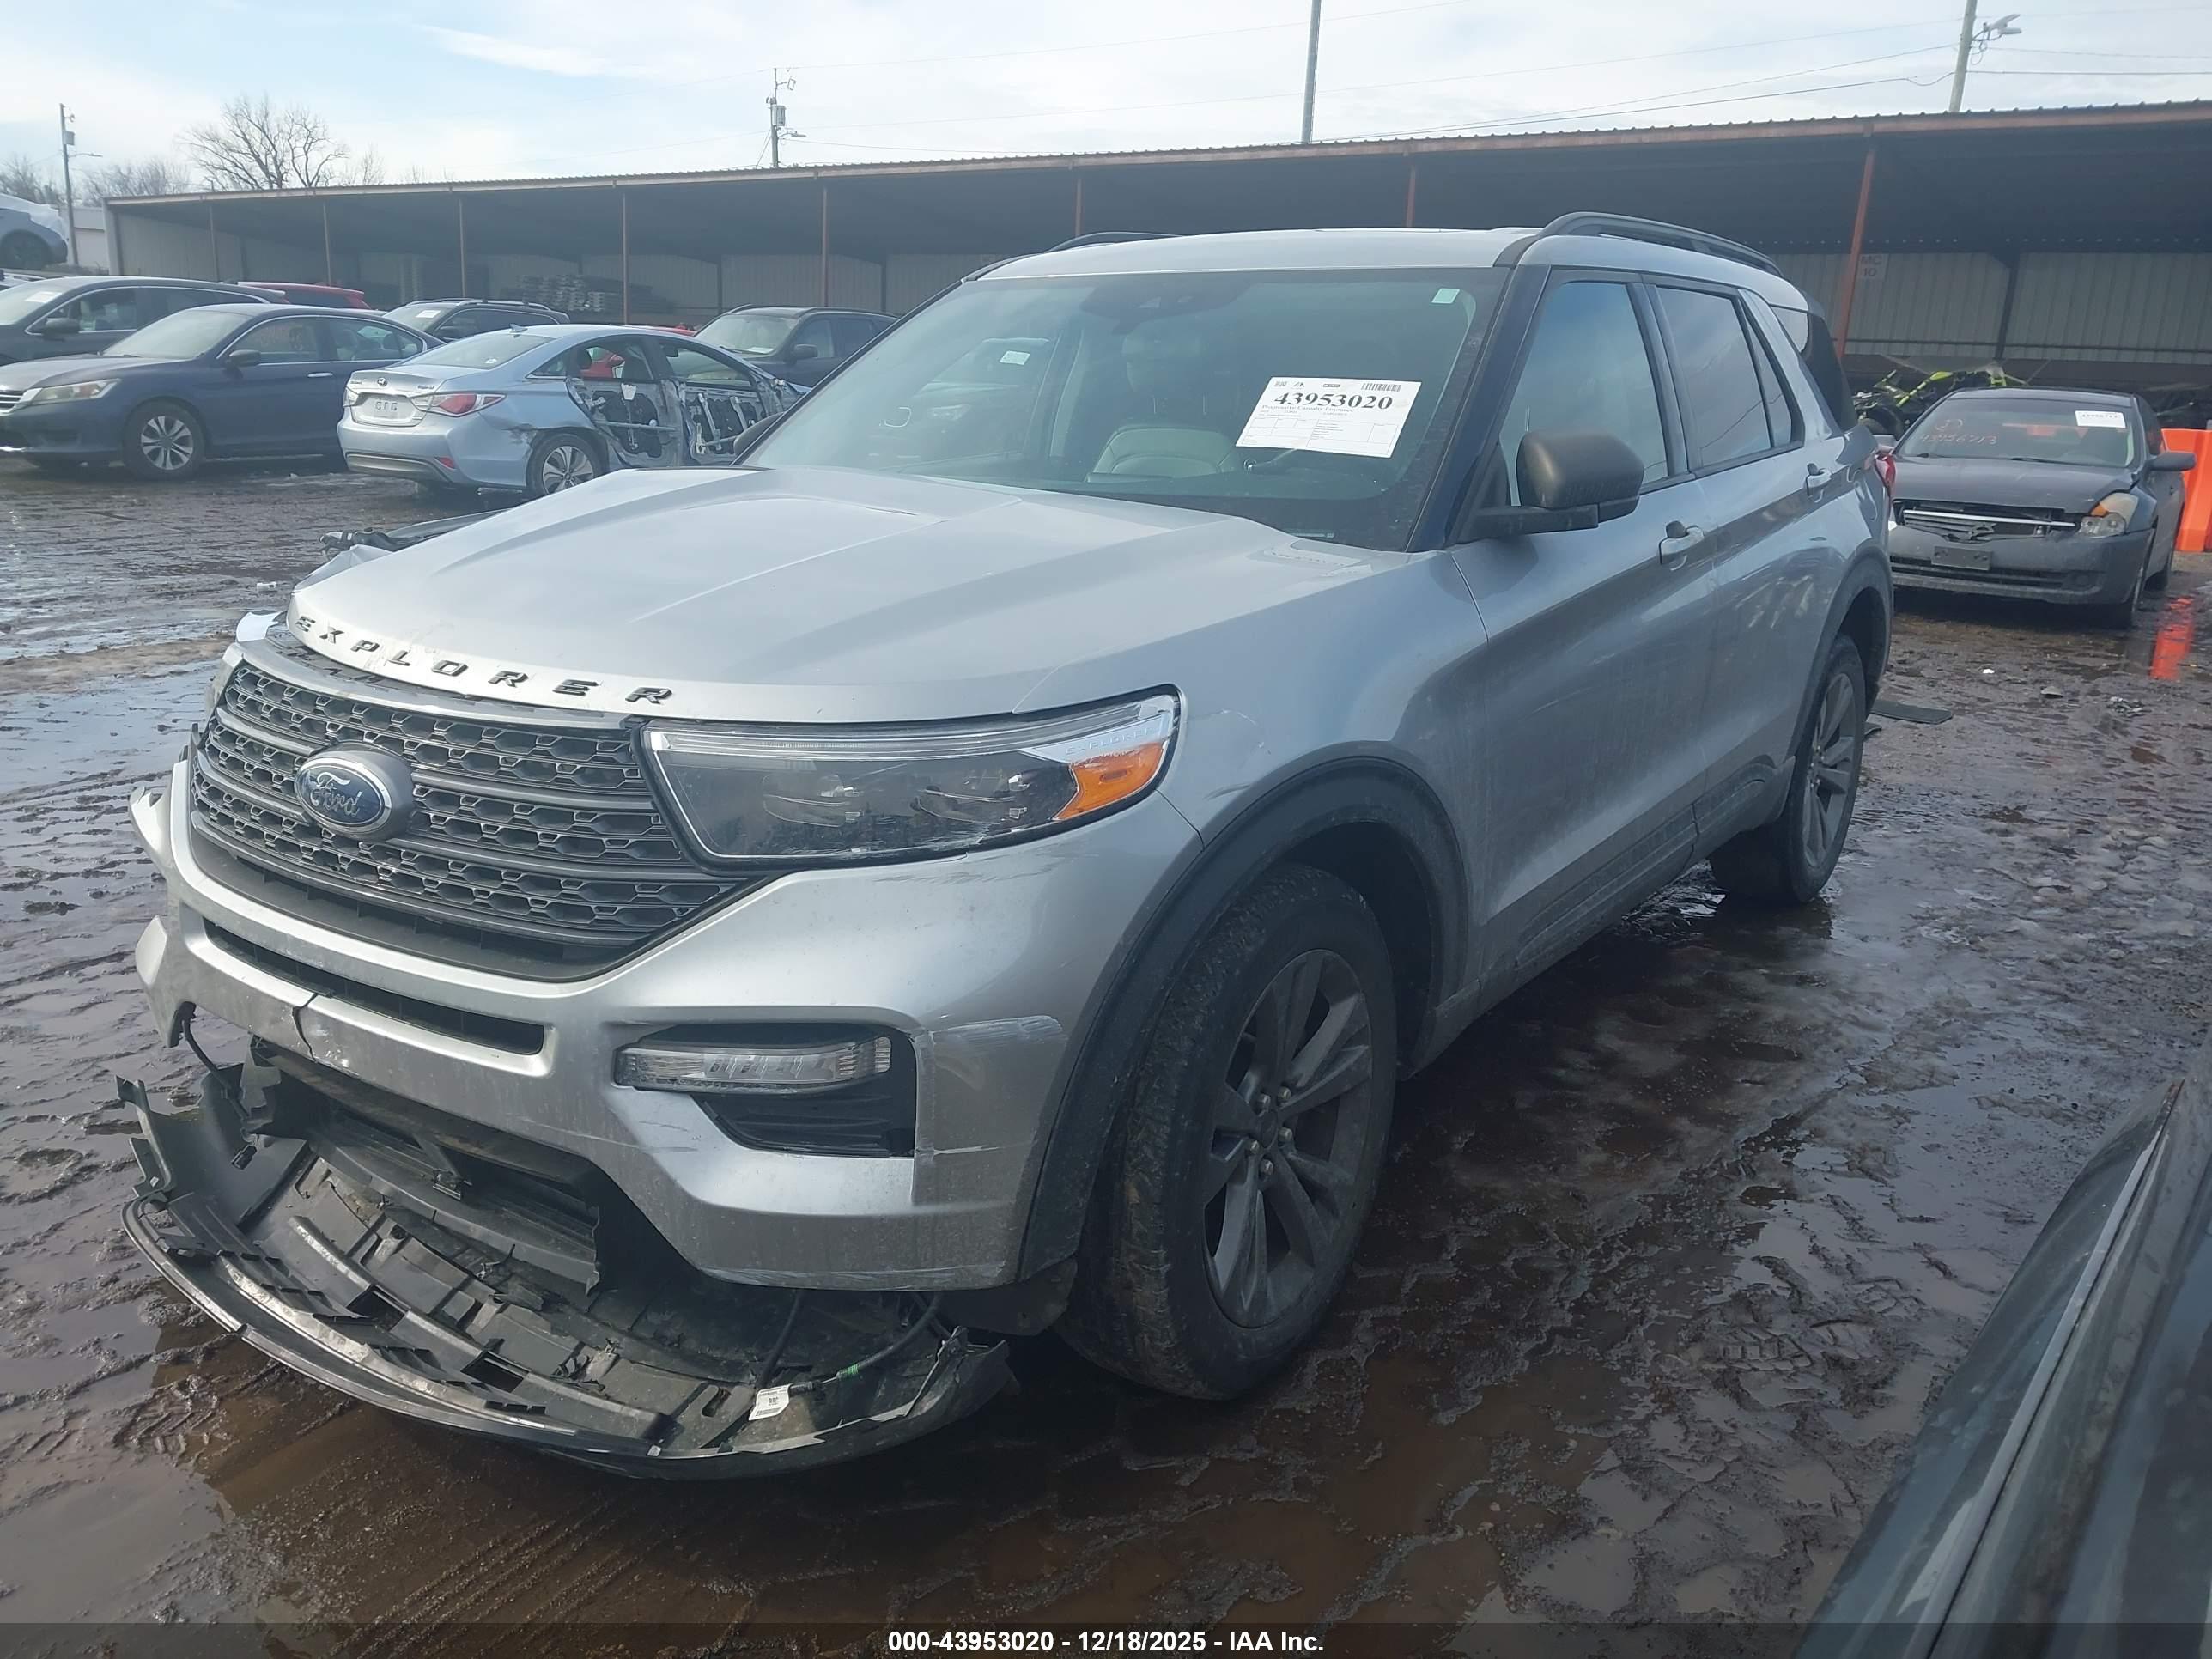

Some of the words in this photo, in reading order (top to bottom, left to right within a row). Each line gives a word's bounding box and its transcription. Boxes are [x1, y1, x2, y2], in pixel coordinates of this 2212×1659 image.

[1863, 267, 1877, 276] 10
[1274, 392, 1393, 410] 43953020
[295, 616, 673, 704] EXPLORER
[310, 771, 362, 817] Ford
